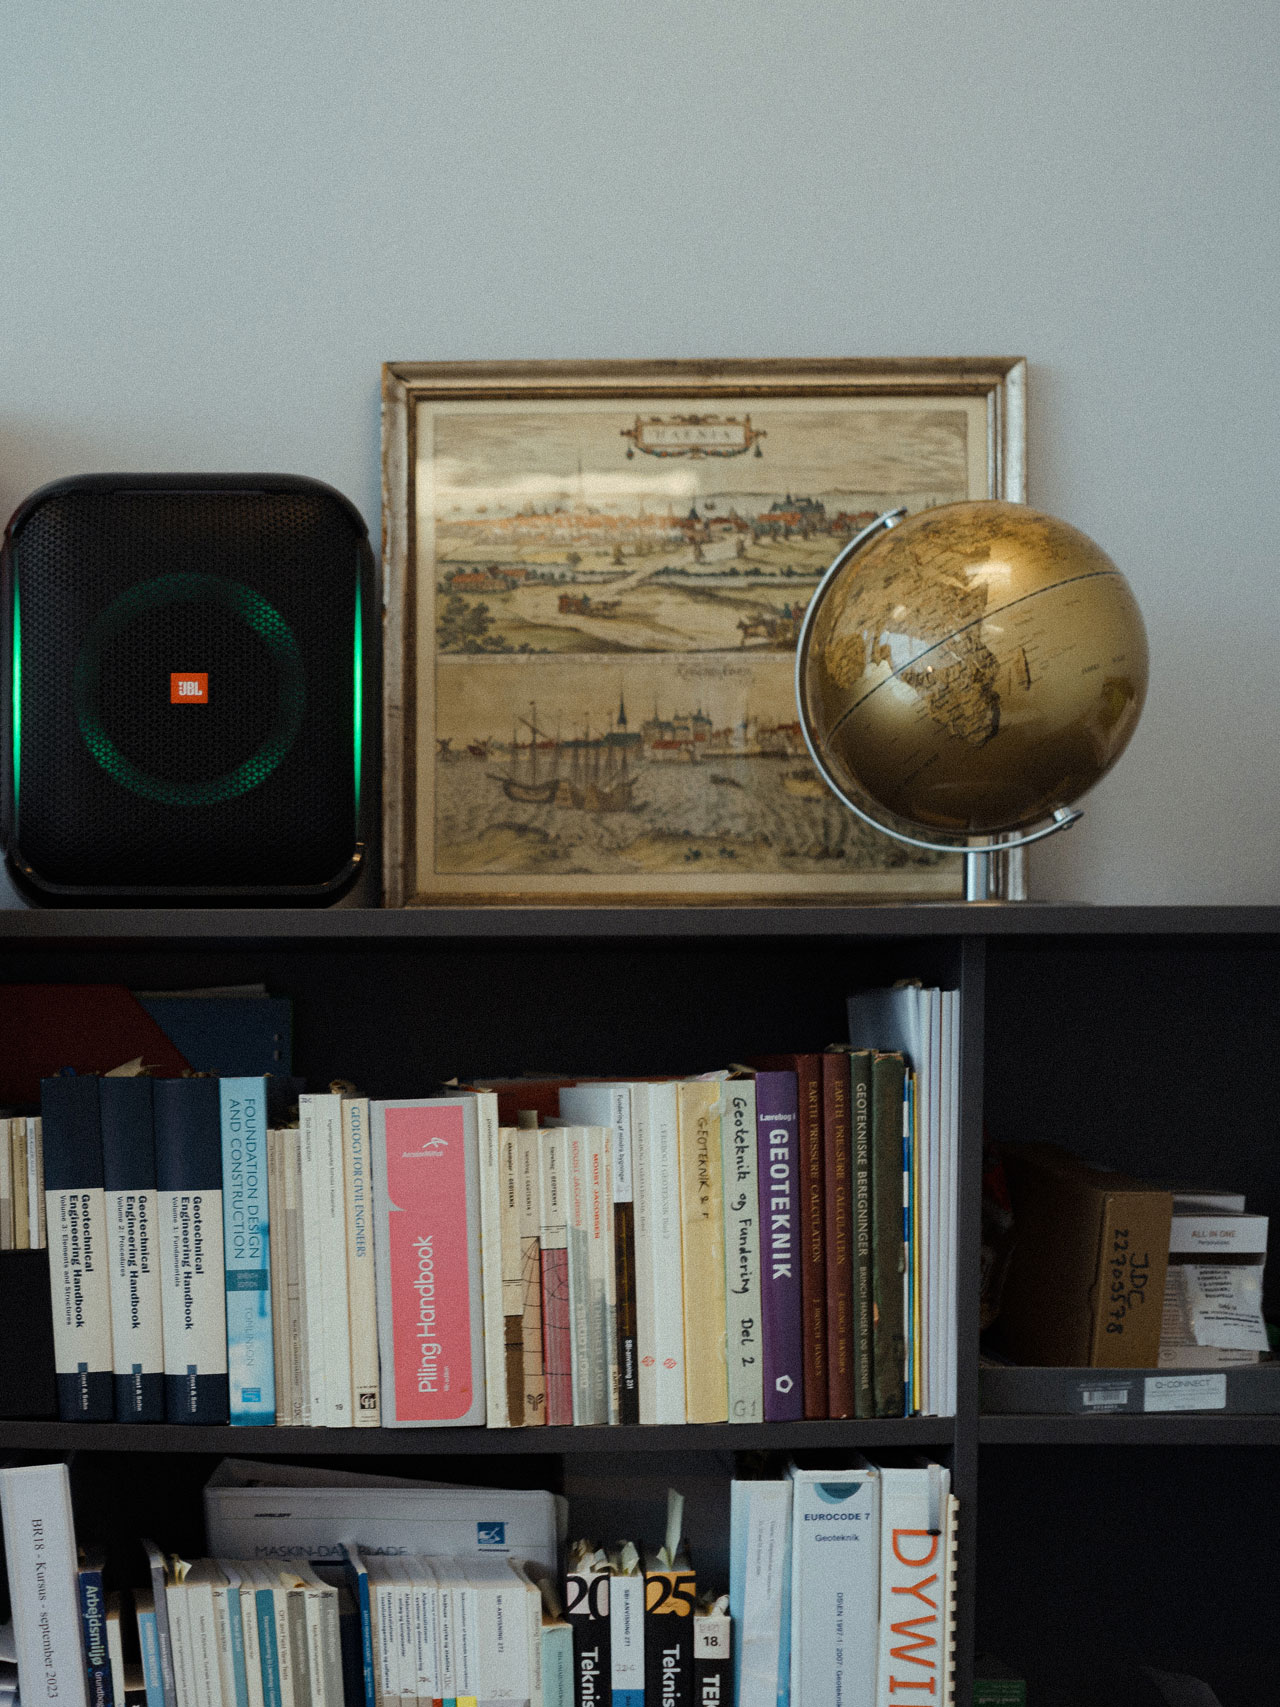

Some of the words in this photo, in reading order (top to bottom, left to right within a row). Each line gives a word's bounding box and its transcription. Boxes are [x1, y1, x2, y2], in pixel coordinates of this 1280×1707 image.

[178, 681, 203, 696] JBL
[229, 1098, 241, 1133] AND
[616, 1094, 624, 1124] Fundering
[808, 1080, 819, 1120] EARTH
[833, 1080, 844, 1118] EARTH
[856, 1082, 868, 1165] GEOTEKNISKE
[244, 1098, 258, 1199] FOUNDATION
[351, 1106, 362, 1154] GEOLOGY
[697, 1117, 710, 1193] GEOTEKNIK
[732, 1097, 751, 1182] Geoteknik
[809, 1122, 820, 1179] PRESSURE
[834, 1124, 845, 1179] PRESSURE
[352, 1156, 364, 1176] FOR
[353, 1178, 365, 1202] CIVIL
[617, 1153, 625, 1183] bygninger
[59, 1195, 67, 1222] Volume
[117, 1195, 125, 1222] Volume
[171, 1196, 179, 1223] Volume
[230, 1138, 245, 1259] CONSTRUCTION
[731, 1193, 747, 1211] og
[769, 1128, 792, 1280] GEOTEKNIK
[810, 1184, 821, 1263] CALCULATION
[857, 1171, 869, 1256] BEREGNINGER
[68, 1195, 81, 1266] Engineering
[81, 1194, 94, 1272] Geotechnical
[125, 1196, 137, 1267] Engineering
[138, 1195, 150, 1274] Geotechnical
[180, 1196, 191, 1267] Engineering
[192, 1196, 204, 1275] Geotechnical
[247, 1205, 260, 1258] DESIGN
[354, 1204, 367, 1258] ENGINEERS
[835, 1185, 847, 1265] CALCULATION
[1191, 1230, 1207, 1238] ALL
[1219, 1230, 1237, 1238] ONE
[62, 1234, 70, 1268] Elements
[731, 1218, 752, 1295] Fundering
[64, 1287, 72, 1325] Structures
[72, 1269, 85, 1328] Handbook
[129, 1270, 140, 1329] Handbook
[183, 1271, 195, 1330] Handbook
[412, 1235, 436, 1337] Handbook
[859, 1266, 868, 1298] BRINCH
[1127, 1252, 1151, 1309] JDC
[245, 1307, 255, 1367] TOMLINSON
[740, 1318, 755, 1346] Del
[859, 1302, 868, 1336] HANSEN
[415, 1343, 443, 1393] Piling
[741, 1357, 755, 1367] 2
[860, 1353, 869, 1390] HESSNER
[1155, 1379, 1212, 1389] Q-CONNECT
[31, 1518, 45, 1551] BR18
[804, 1513, 861, 1521] EUROCODE
[864, 1513, 871, 1521] 7
[815, 1534, 859, 1542] Geoteknik
[255, 1545, 409, 1557] MASKIN-DABLADE
[34, 1562, 48, 1601] Kursus
[566, 1574, 610, 1618] 20
[645, 1574, 696, 1618] 25
[37, 1611, 55, 1668] september
[84, 1585, 105, 1666] Arbejdsmiljø
[888, 1528, 939, 1707] DYWI
[45, 1671, 59, 1699] 2023
[581, 1646, 601, 1707] Teknis
[662, 1644, 682, 1707] Teknis
